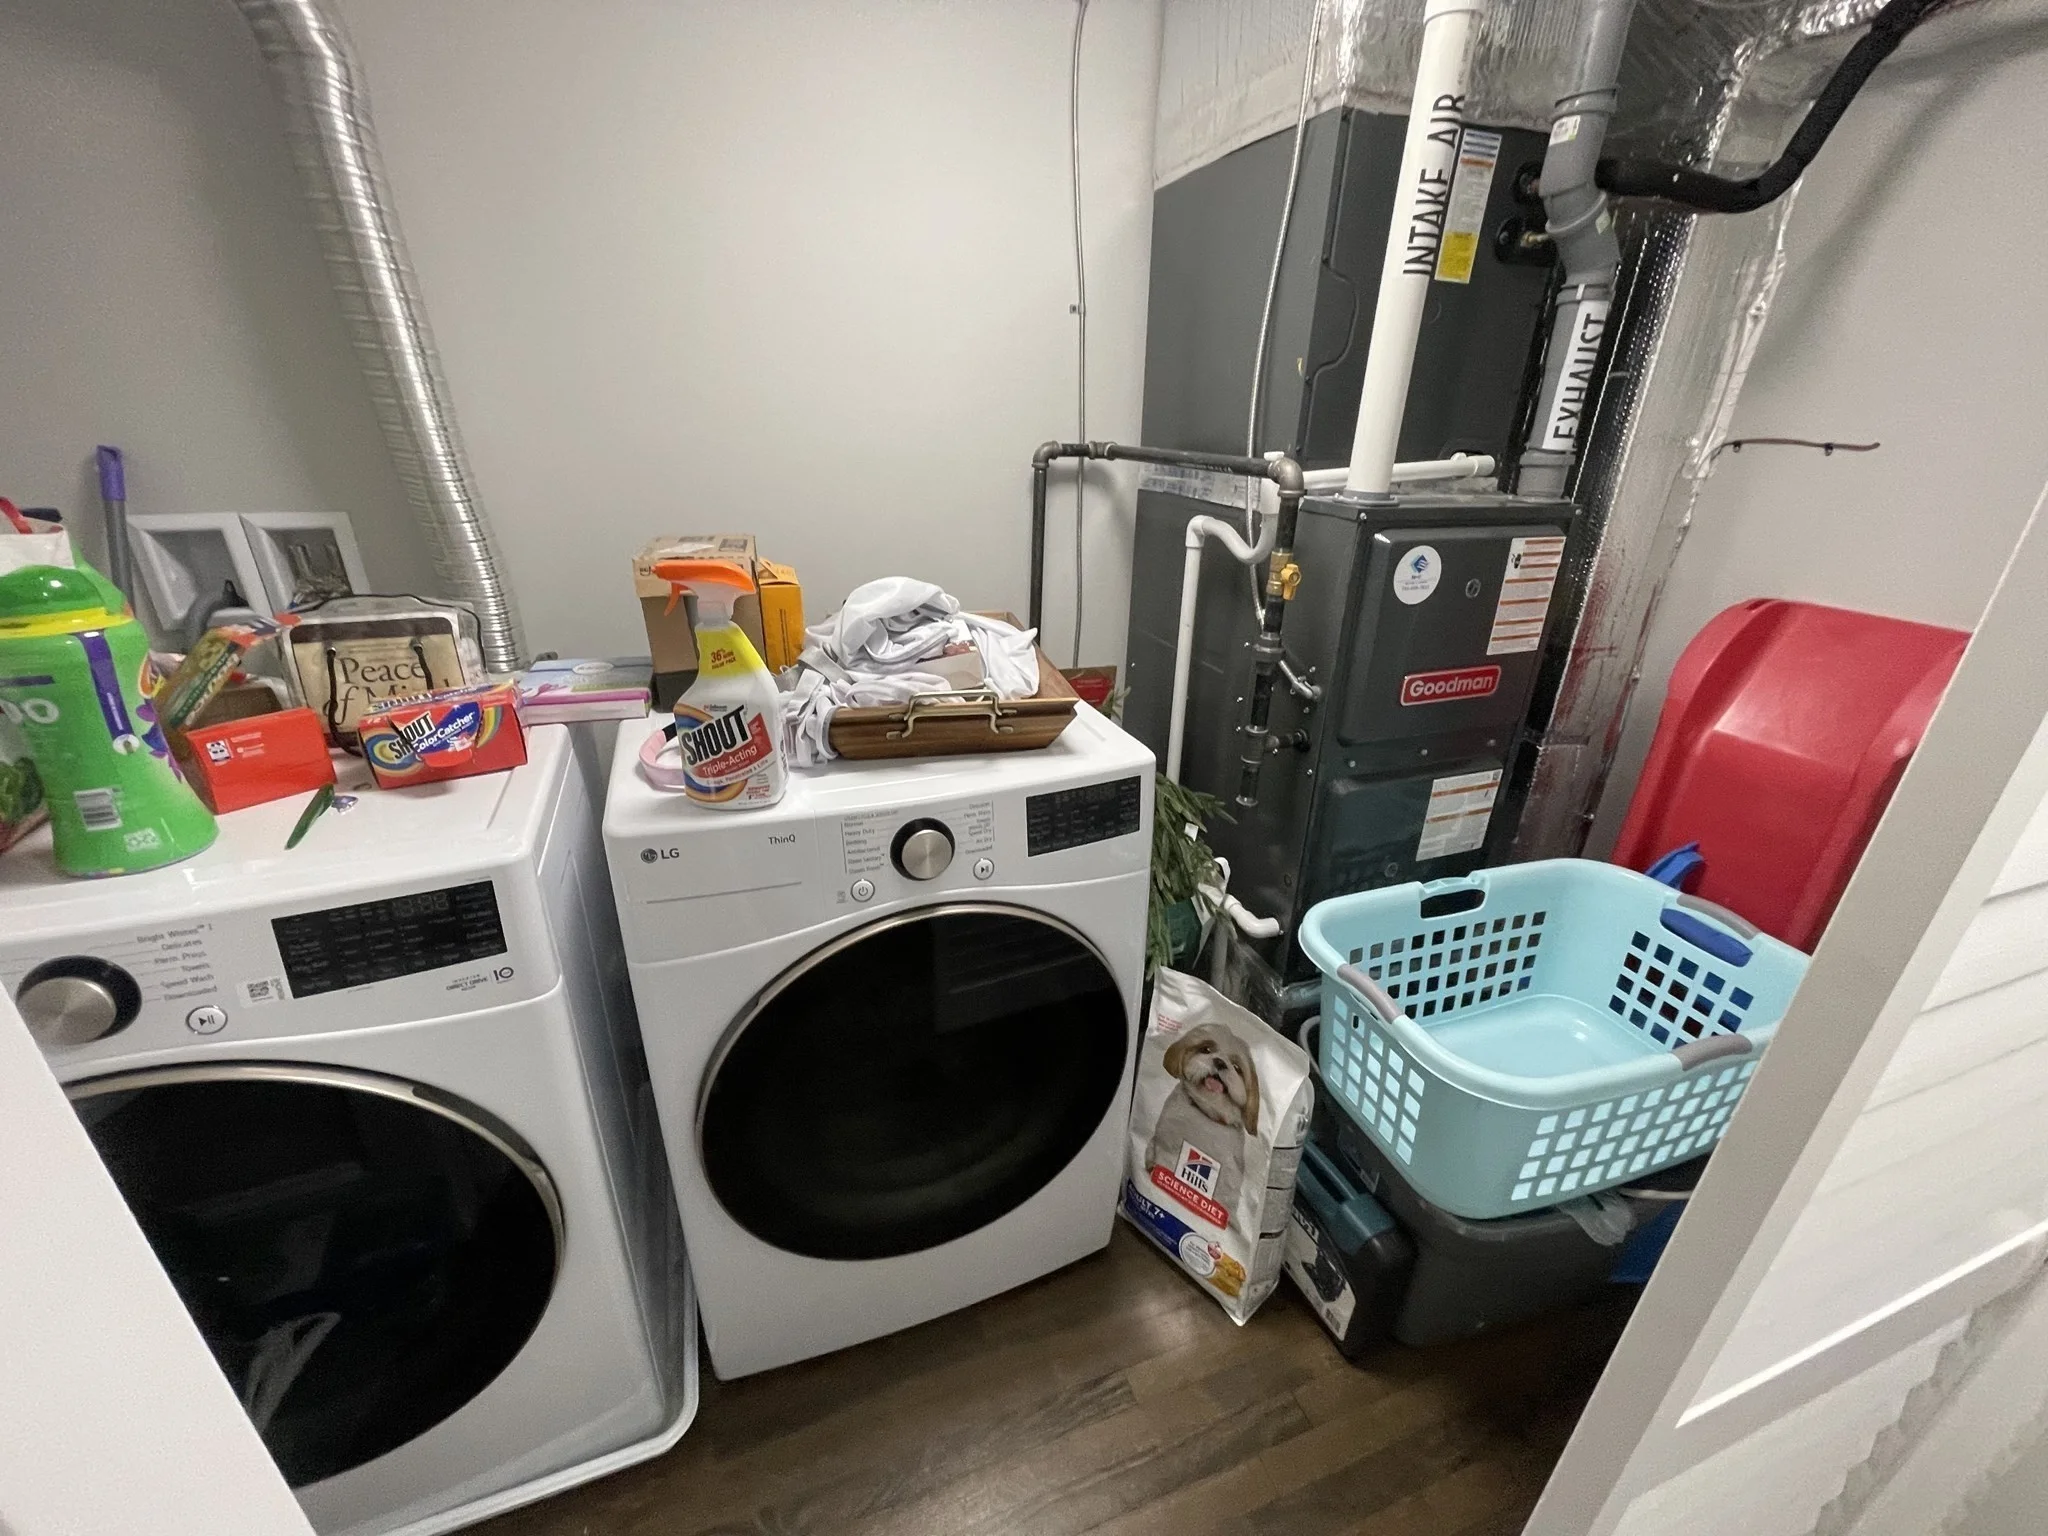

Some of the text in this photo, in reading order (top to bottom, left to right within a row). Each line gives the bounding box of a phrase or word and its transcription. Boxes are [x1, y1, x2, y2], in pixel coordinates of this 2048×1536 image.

[1403, 94, 1465, 275] INTAKE AIR
[1553, 312, 1606, 439] EXHAUST
[339, 657, 425, 684] Peace
[1409, 675, 1493, 697] Goodman
[388, 712, 434, 760] SHOUT
[681, 704, 749, 766] SHOUT
[702, 744, 758, 778] Triple-Acting
[660, 834, 796, 860] LG ThinQ
[1158, 1171, 1225, 1220] SCIENCE DIET
[1181, 1167, 1209, 1193] Hill's
